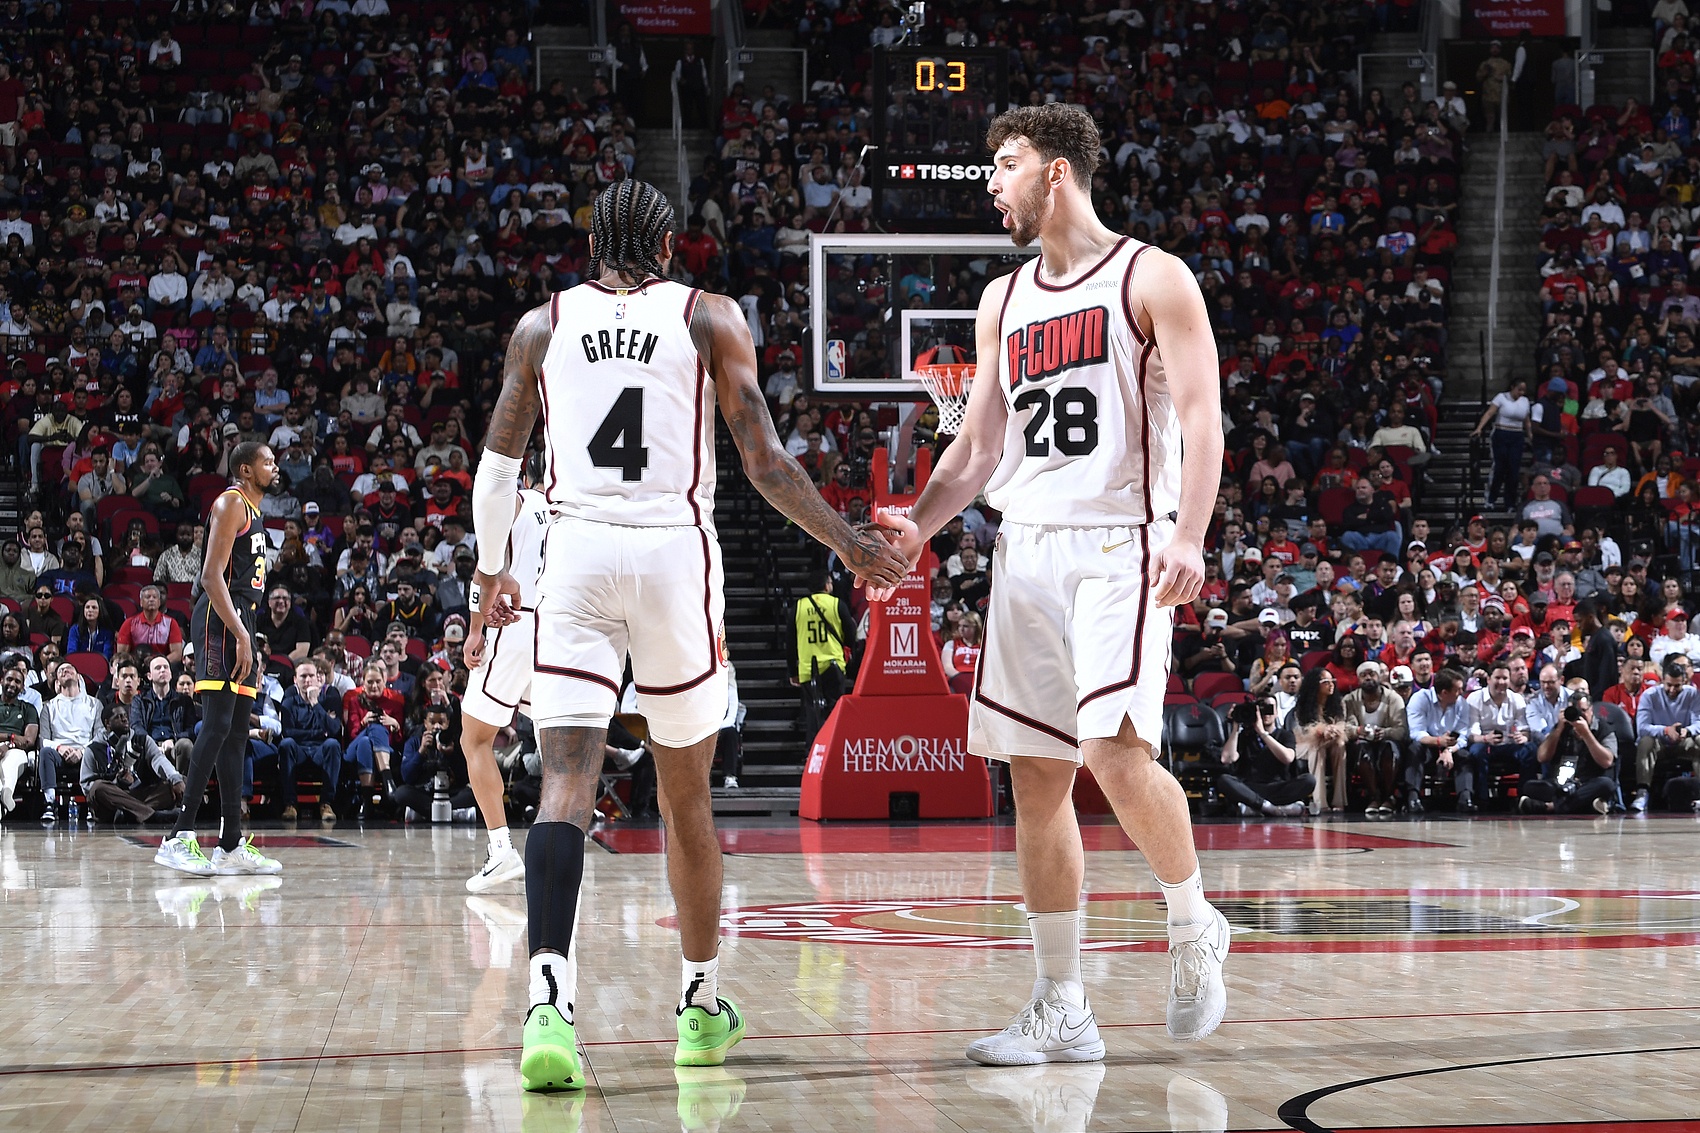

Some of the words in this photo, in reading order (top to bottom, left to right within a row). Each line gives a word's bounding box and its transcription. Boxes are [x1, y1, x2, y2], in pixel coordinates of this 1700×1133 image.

[620, 4, 656, 14] Events.
[658, 4, 696, 15] Tickets.
[637, 17, 679, 26] Rockets.
[916, 61, 966, 91] 0.3
[917, 164, 995, 180] TISSOT
[581, 328, 659, 365] GREEN
[1013, 387, 1099, 457] 28
[586, 385, 649, 483] 4
[250, 532, 267, 555] PH
[251, 556, 266, 591] 3
[885, 606, 922, 616] 222-2222
[808, 621, 828, 643] 50
[894, 626, 914, 654] M
[1290, 630, 1321, 640] PHX
[843, 736, 966, 756] MEMORIAL
[843, 754, 965, 772] HERMANN
